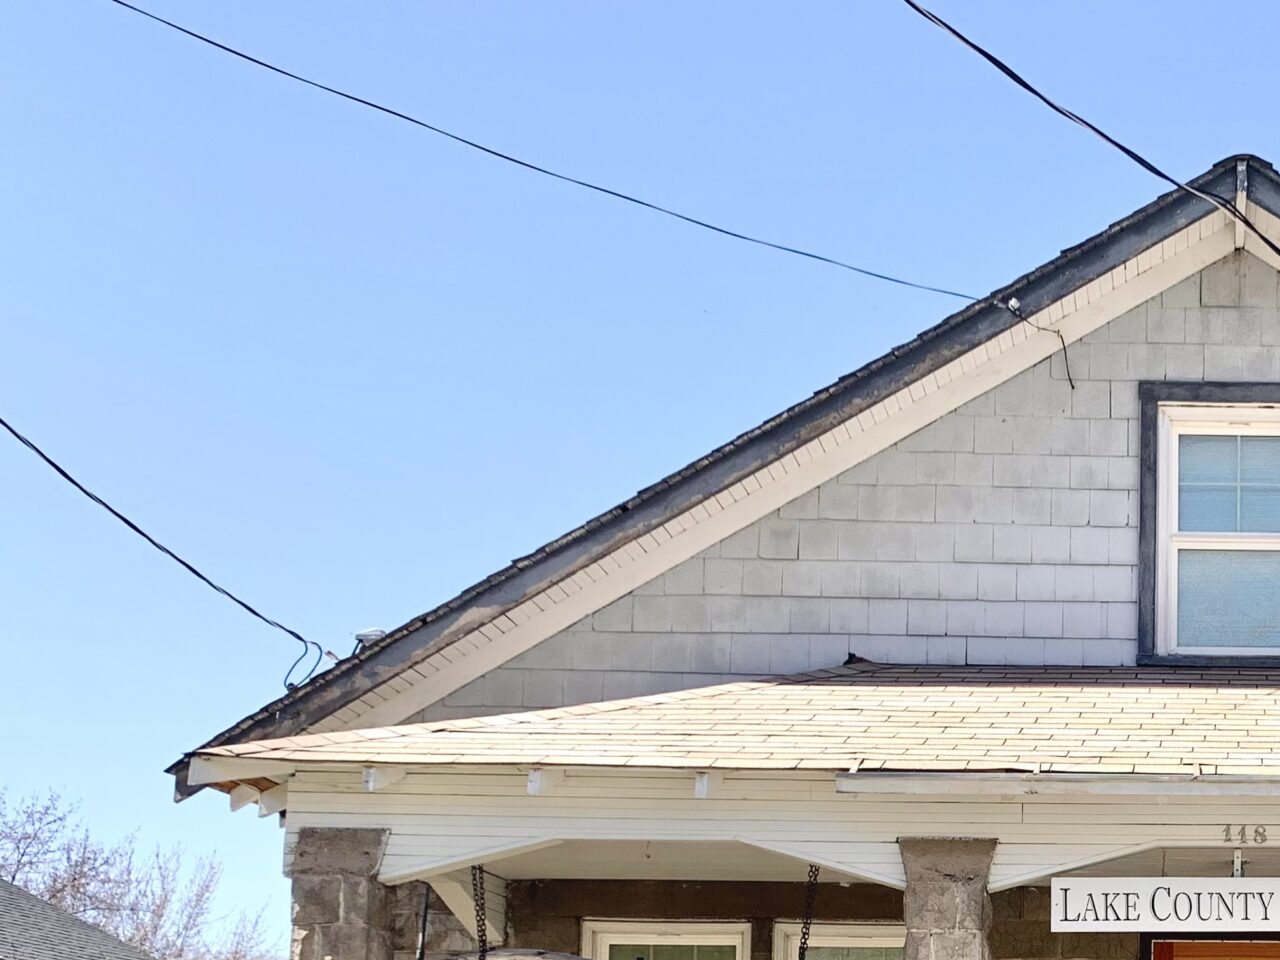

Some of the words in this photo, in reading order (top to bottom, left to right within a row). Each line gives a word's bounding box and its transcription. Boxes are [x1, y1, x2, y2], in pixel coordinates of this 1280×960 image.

[1222, 824, 1267, 844] 118
[1059, 887, 1141, 922] LAKE
[1151, 886, 1275, 922] COUNTY
